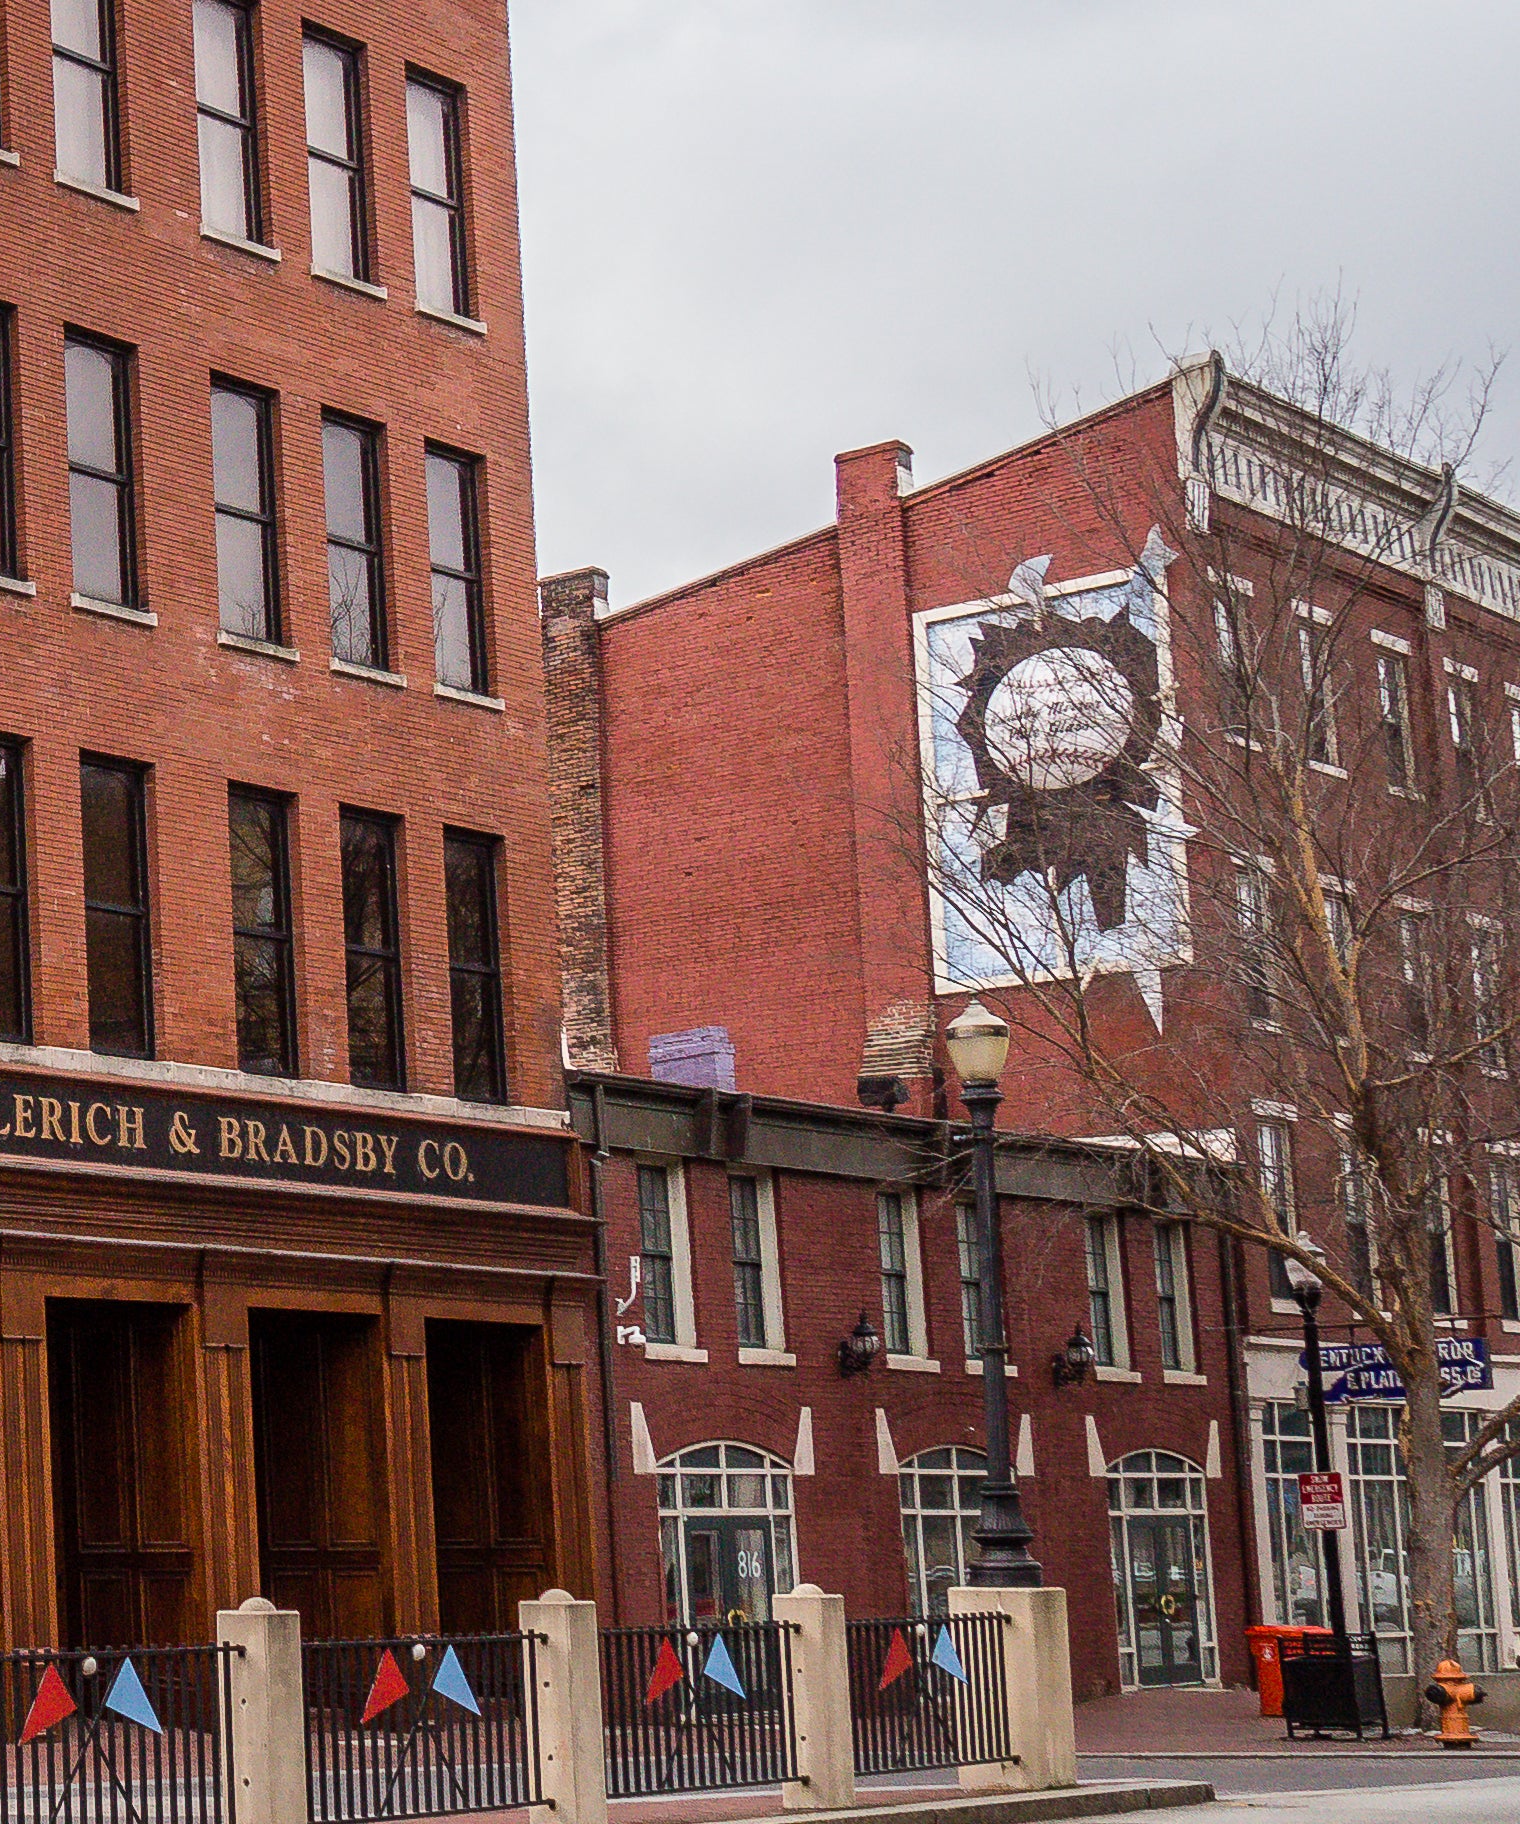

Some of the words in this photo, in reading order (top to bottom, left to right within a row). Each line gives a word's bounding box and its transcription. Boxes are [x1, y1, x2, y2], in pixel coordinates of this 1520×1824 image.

[168, 1111, 200, 1154] &
[217, 1116, 399, 1174] BRADSBY
[418, 1139, 475, 1182] CO.
[1319, 1346, 1393, 1368] ENTUCK
[737, 1550, 761, 1578] 816
